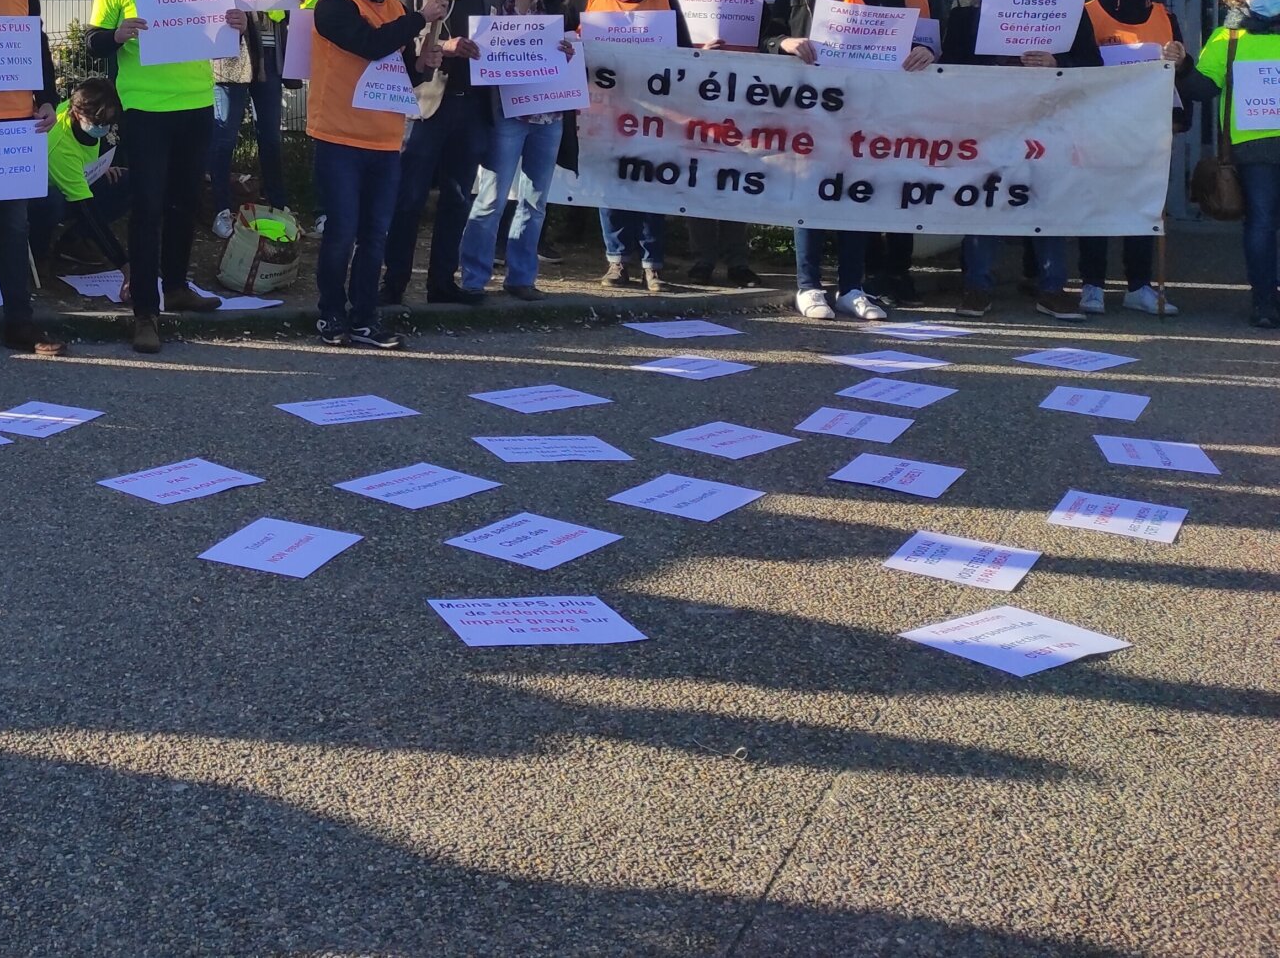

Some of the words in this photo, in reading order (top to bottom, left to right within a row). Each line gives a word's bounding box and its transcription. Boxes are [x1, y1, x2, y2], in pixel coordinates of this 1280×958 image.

[710, 12, 755, 22] CONDITIONS
[997, 10, 1068, 20] surchargées
[162, 17, 183, 28] NOS
[186, 14, 225, 26] POSTES
[490, 21, 521, 31] Aider
[524, 22, 545, 31] nos
[846, 17, 857, 25] UN
[9, 23, 31, 33] PLUS
[608, 26, 649, 34] PROJETS
[829, 23, 898, 36] FORMIDABLE
[999, 22, 1061, 32] Génération
[5, 41, 22, 49] AVEC
[490, 36, 526, 46] élèves
[530, 38, 543, 46] en
[1005, 35, 1052, 45] sacrifiée
[846, 43, 862, 51] DES
[864, 43, 897, 52] MOYENS
[820, 48, 846, 59] FORT
[848, 52, 897, 62] MINABLES
[7, 56, 33, 65] MOINS
[480, 68, 502, 78] Pas
[505, 66, 559, 78] essentiel
[1258, 67, 1272, 75] ET
[365, 82, 385, 90] AVEC
[386, 84, 402, 92] DES
[363, 91, 387, 100] FORT
[511, 95, 531, 105] DES
[533, 89, 582, 102] STAGIAIRES
[1245, 98, 1276, 106] VOUS
[1247, 108, 1259, 116] 35
[617, 112, 664, 138] en
[850, 130, 979, 166] temps
[3, 146, 33, 155] MOYEN
[8, 165, 31, 174] ZERO
[818, 173, 874, 203] de
[901, 172, 1031, 209] profs
[439, 601, 492, 609] Moins
[559, 599, 596, 609] plus
[465, 609, 486, 617] de
[491, 608, 588, 616] sédentarité
[460, 617, 520, 626] Impact
[526, 617, 576, 626] grave
[580, 616, 610, 624] sur
[508, 626, 526, 634] la
[530, 625, 580, 633] santé
